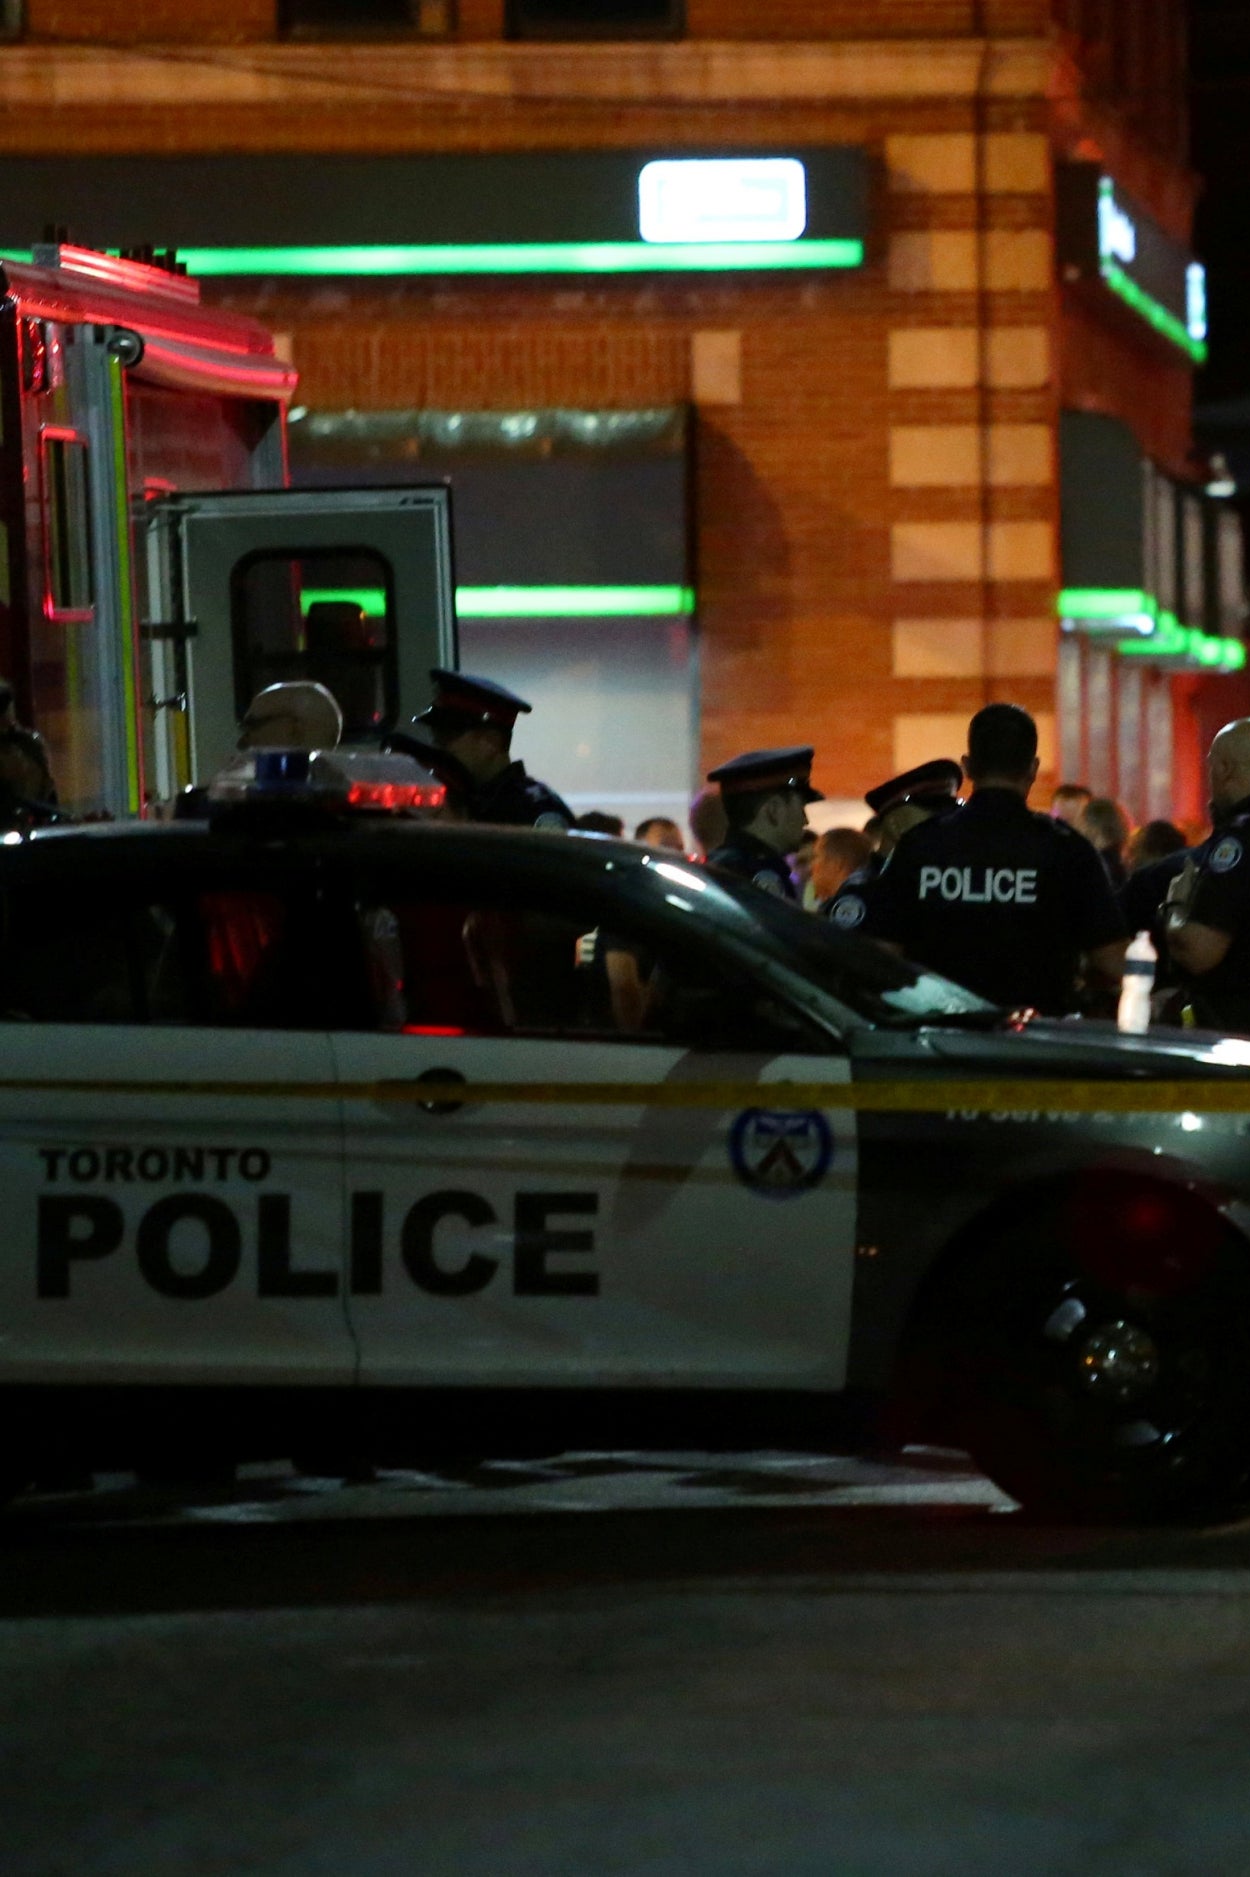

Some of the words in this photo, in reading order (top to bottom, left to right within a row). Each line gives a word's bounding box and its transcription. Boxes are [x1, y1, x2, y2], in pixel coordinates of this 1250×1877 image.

[919, 866, 1038, 903] POLICE
[40, 1147, 272, 1183] TORONTO
[36, 1190, 600, 1299] POLICE
